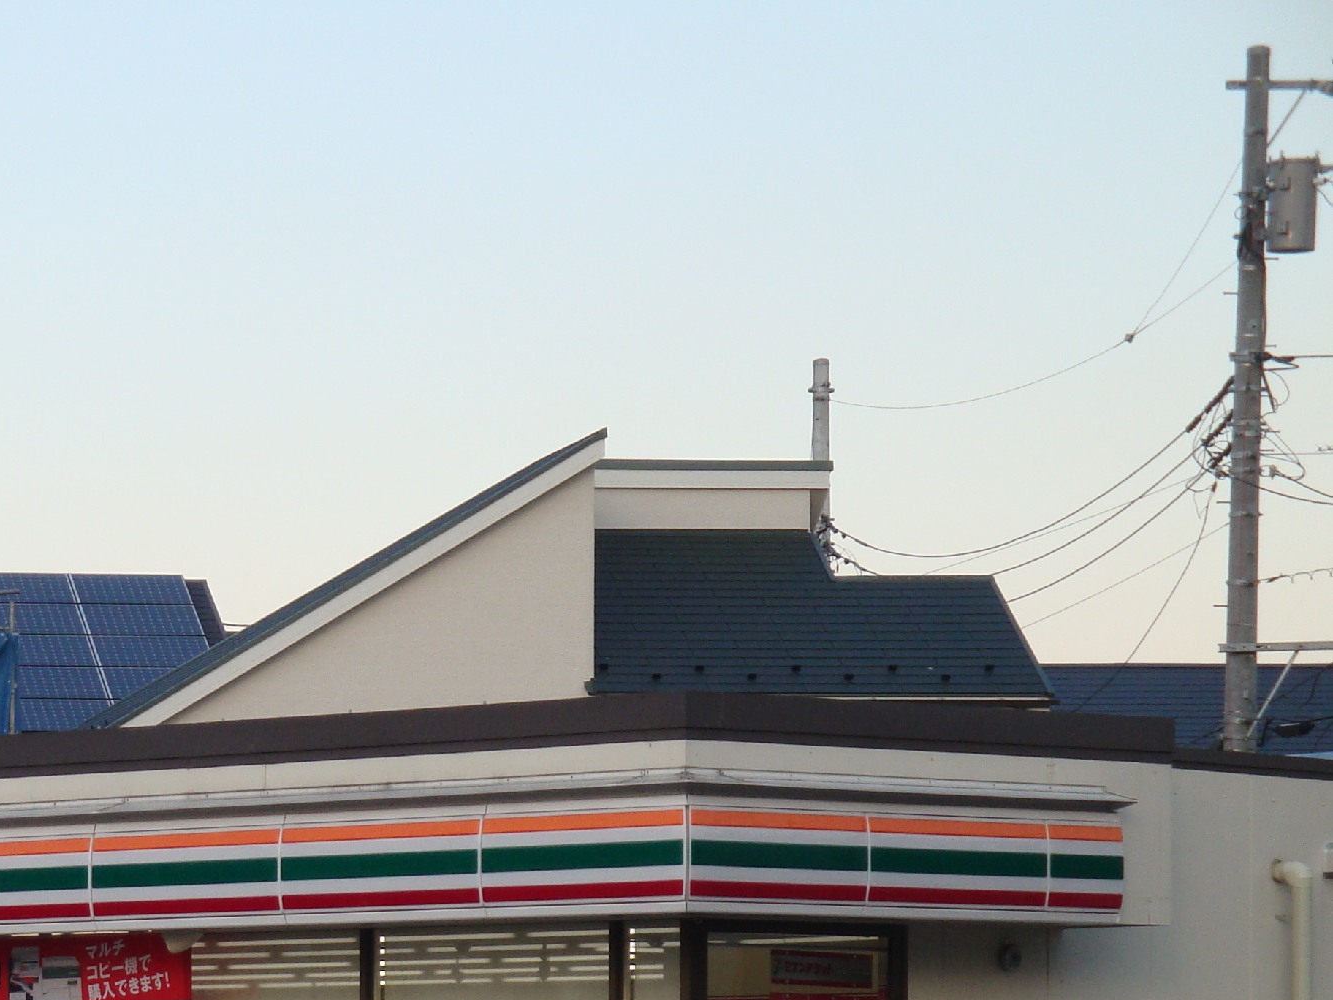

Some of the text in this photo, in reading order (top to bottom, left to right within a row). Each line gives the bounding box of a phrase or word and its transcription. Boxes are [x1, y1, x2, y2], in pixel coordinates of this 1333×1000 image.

[85, 938, 125, 959] マルチ
[86, 954, 151, 980] コピー機で
